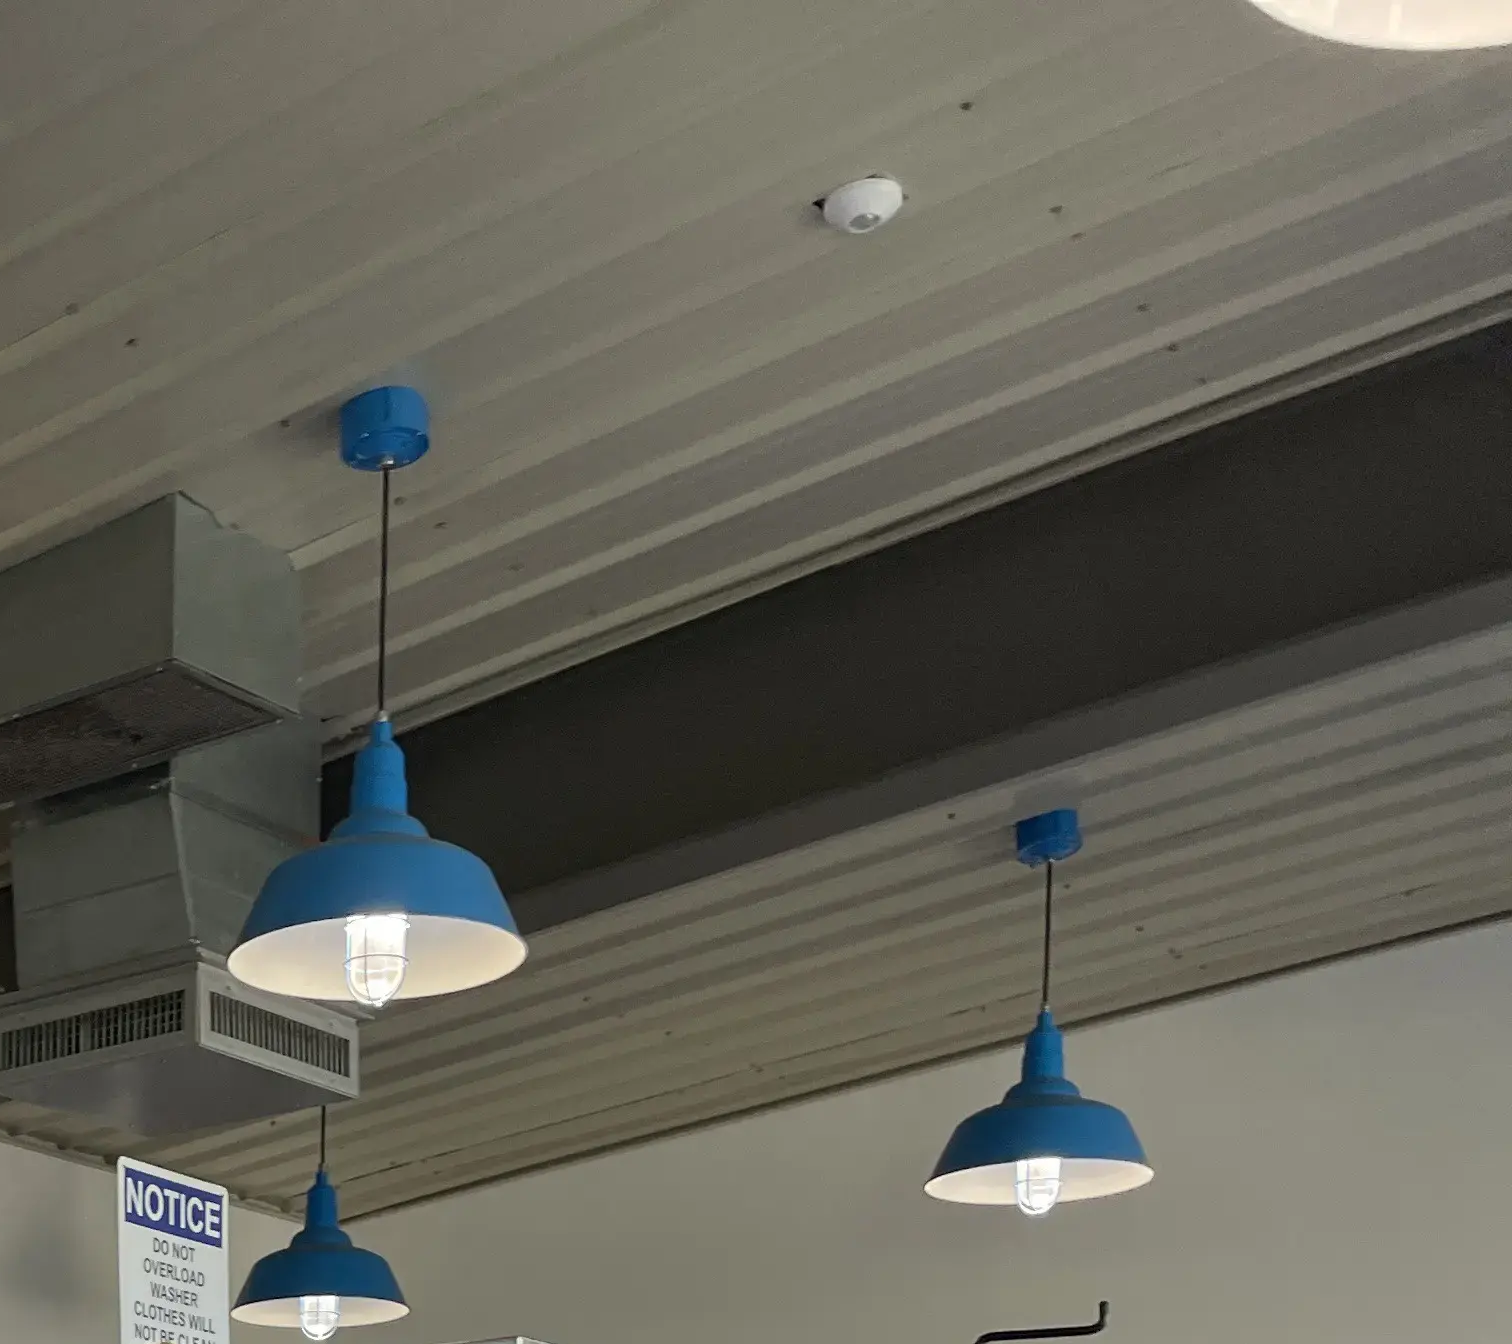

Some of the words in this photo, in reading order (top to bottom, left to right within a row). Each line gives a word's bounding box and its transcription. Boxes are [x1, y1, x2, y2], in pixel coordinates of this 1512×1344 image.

[126, 1177, 220, 1239] NOTICE
[153, 1238, 169, 1254] DO
[172, 1242, 195, 1263] NOT
[143, 1258, 205, 1287] OVERLOAD
[150, 1281, 199, 1308] WASHER
[134, 1301, 186, 1327] CLOTHES
[188, 1314, 216, 1334] WILL
[134, 1324, 158, 1342] NOT
